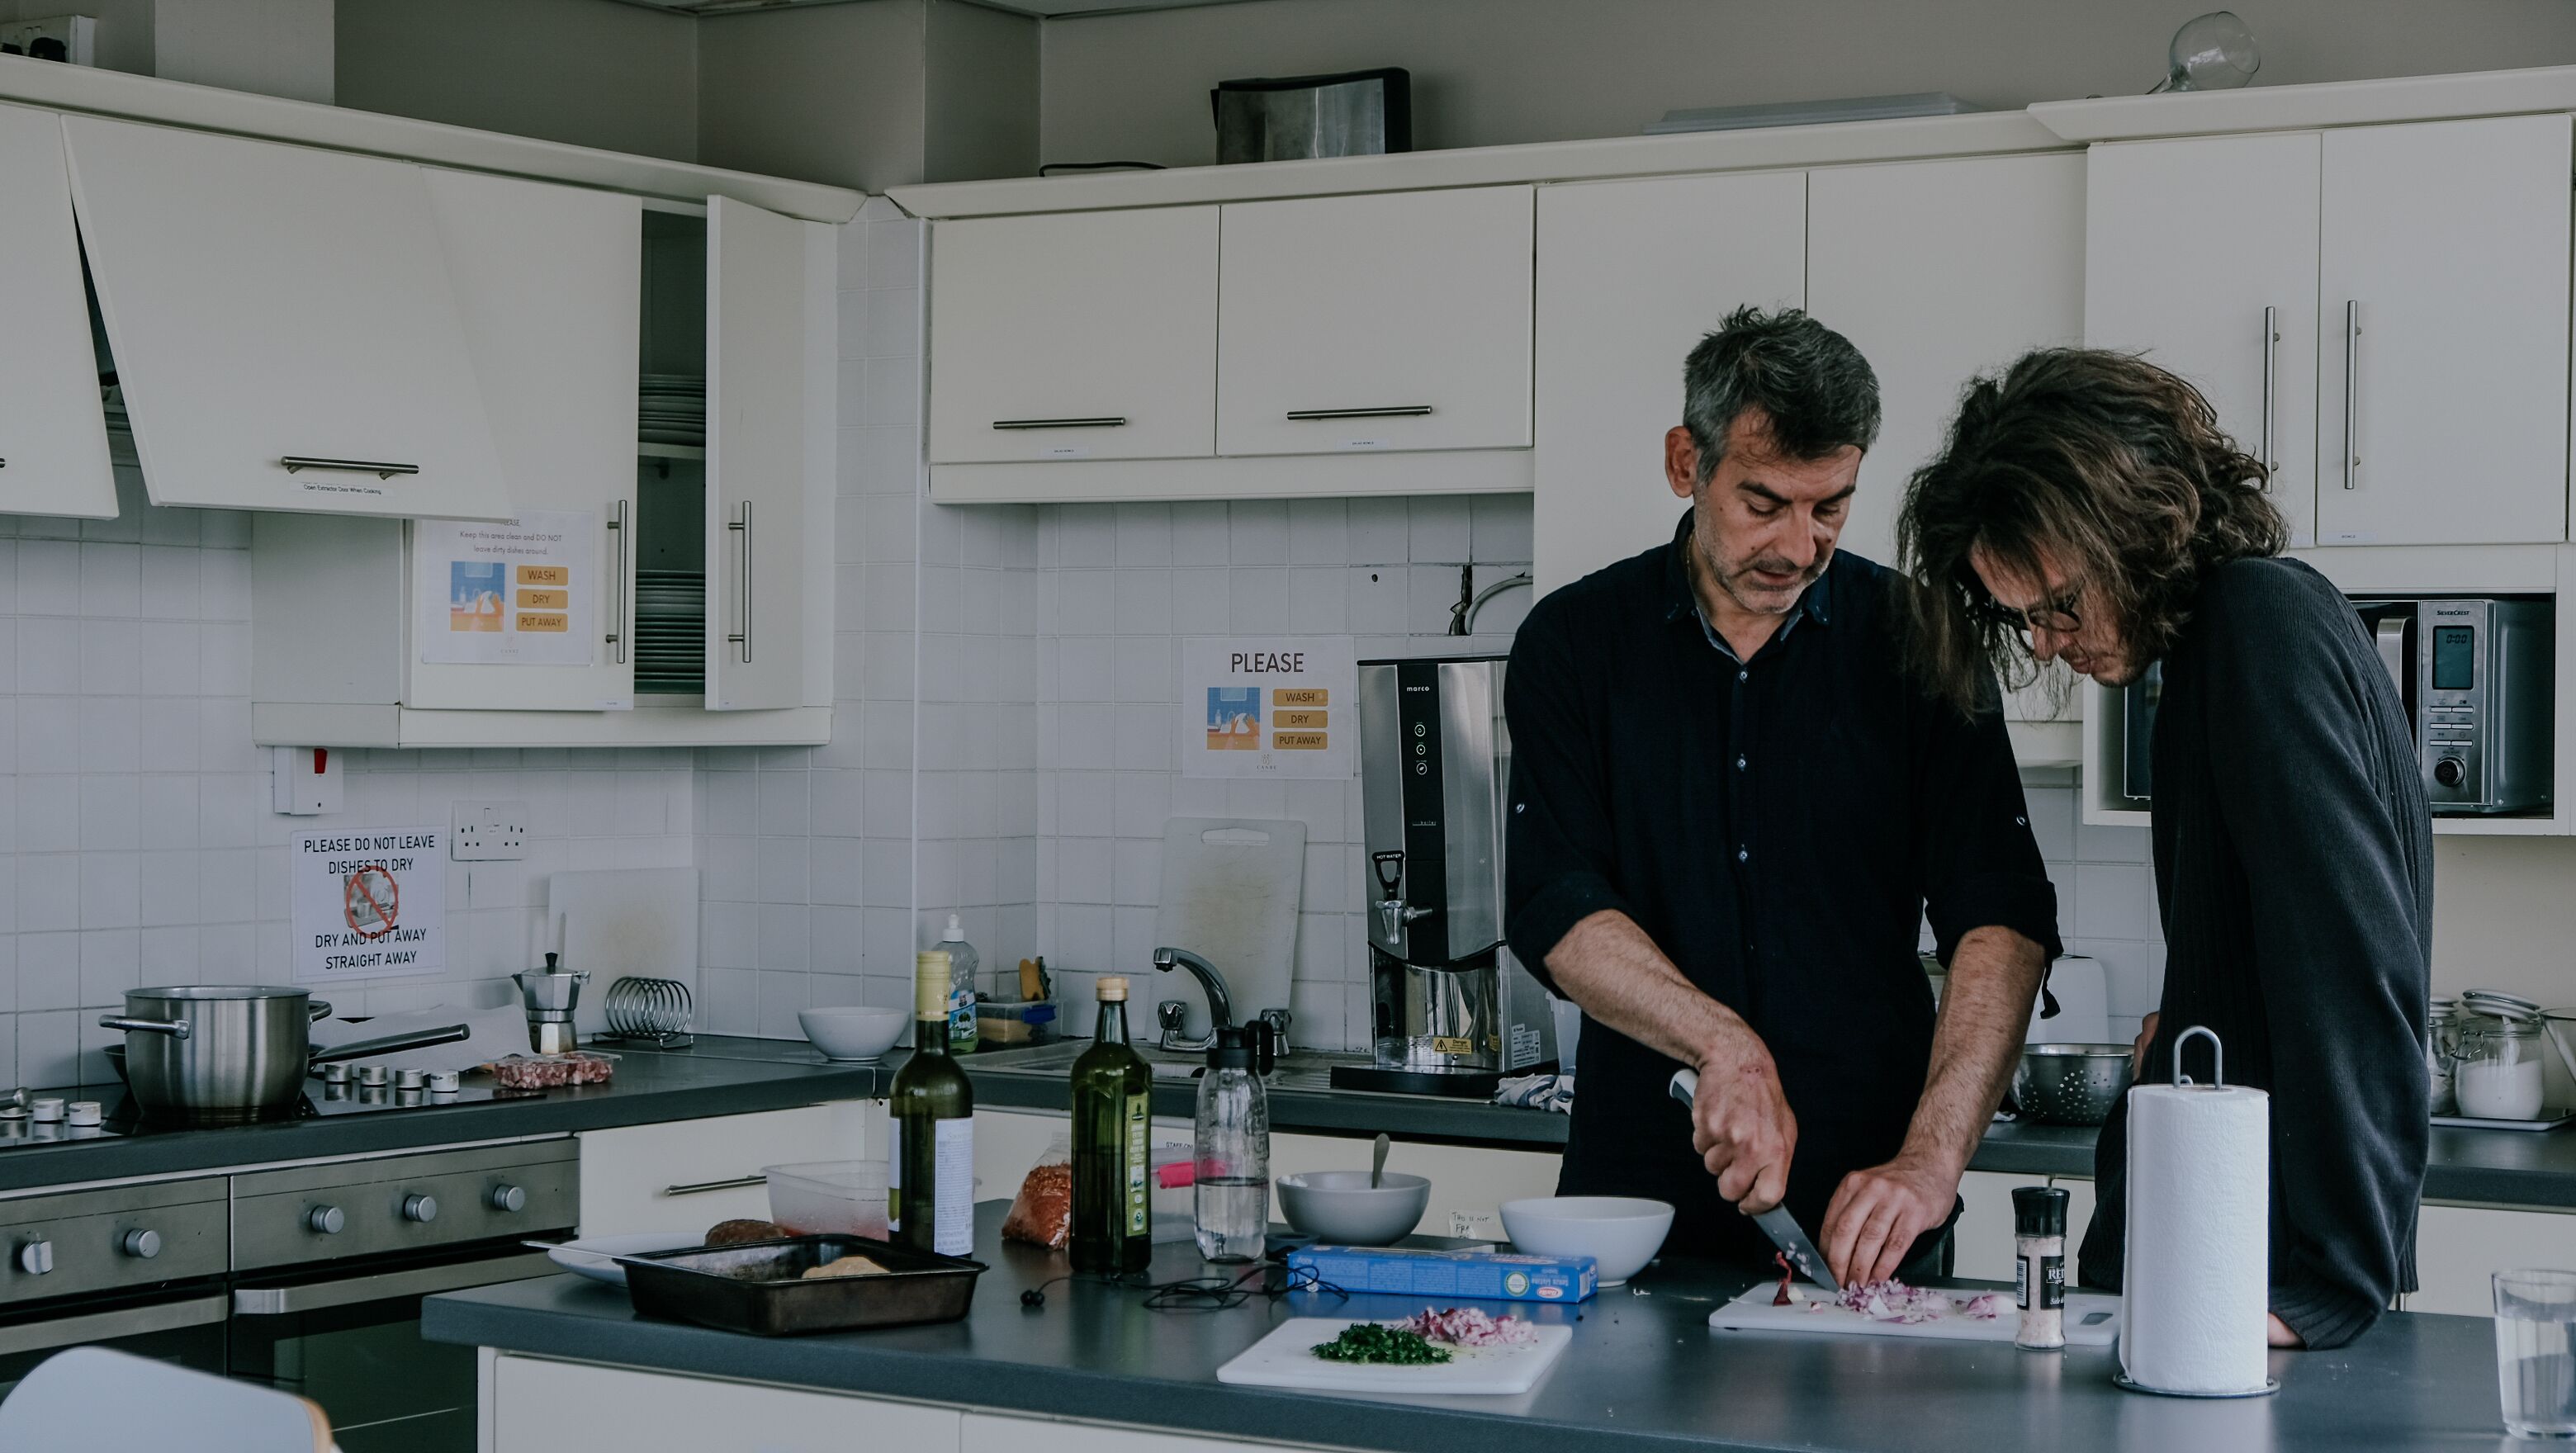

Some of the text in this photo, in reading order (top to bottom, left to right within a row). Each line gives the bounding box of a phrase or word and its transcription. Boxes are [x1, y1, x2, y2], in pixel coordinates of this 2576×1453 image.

[460, 531, 476, 540] Keep
[479, 531, 489, 539] this
[492, 545, 505, 554] dirty
[507, 546, 523, 554] dishes
[528, 570, 556, 580] WASH
[533, 594, 550, 603] DRY
[522, 618, 561, 627] PUT AWAY
[2446, 634, 2468, 644] 0:00
[1231, 652, 1305, 673] PLEASE
[1286, 693, 1314, 703] WASH
[1290, 715, 1309, 724] DRY
[1279, 736, 1321, 745] PUT AWAY
[305, 835, 435, 853] PLEASE DO NOT LEAVE
[329, 858, 414, 874] DISHES TO DRY
[315, 928, 426, 948] DRY AND PUT AWAY
[325, 951, 417, 969] STRAIGHT AWAY
